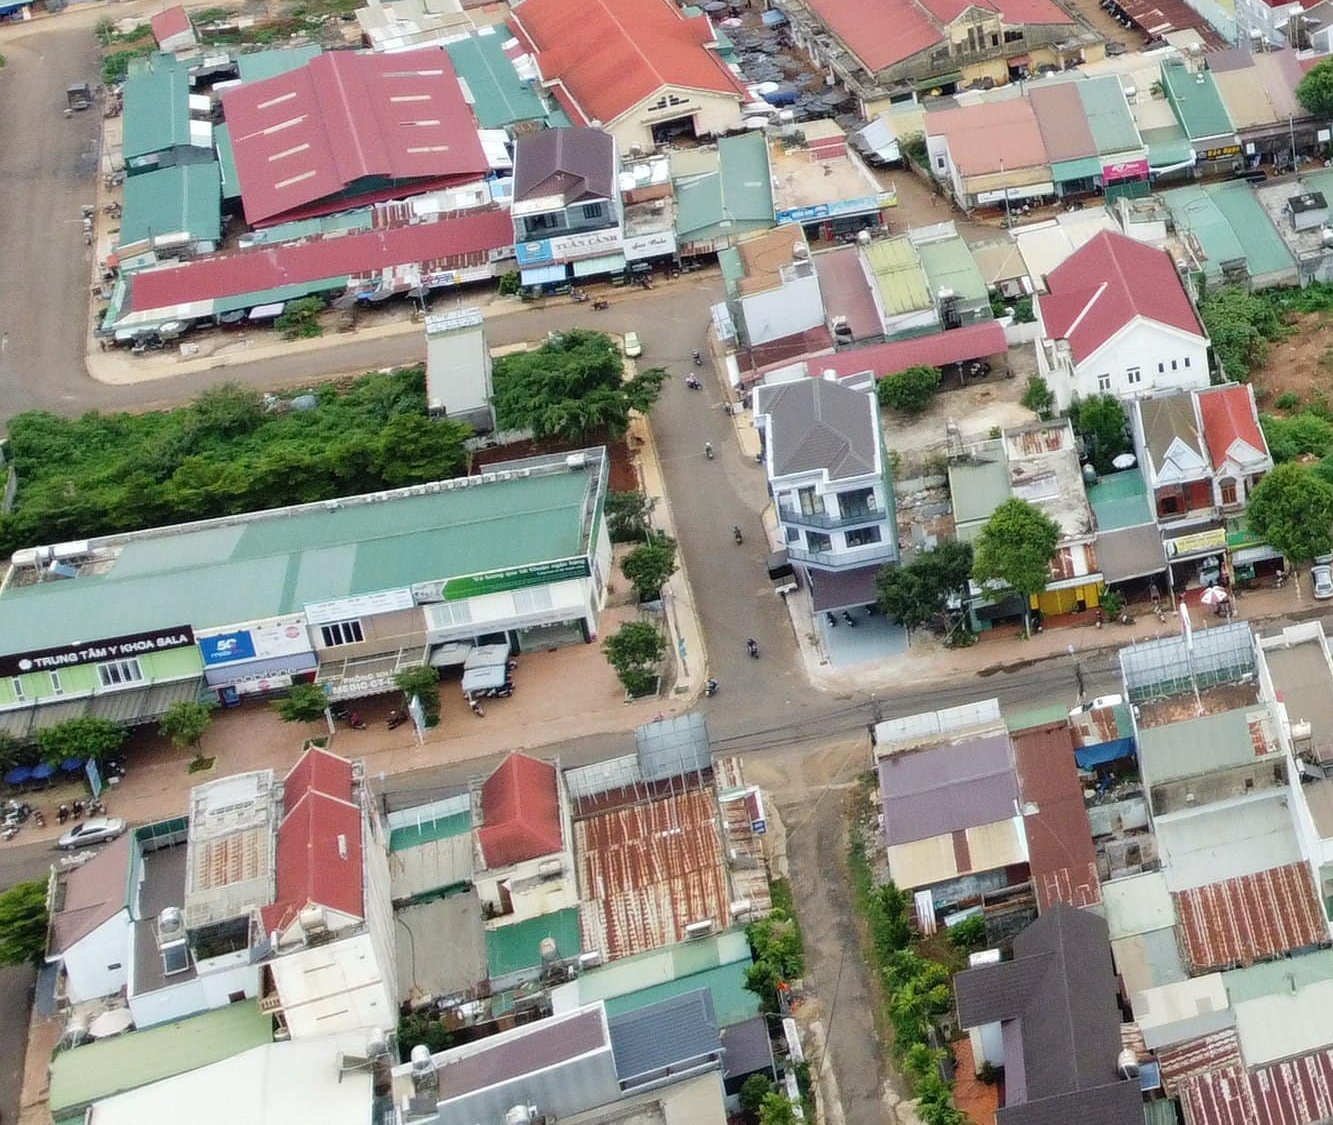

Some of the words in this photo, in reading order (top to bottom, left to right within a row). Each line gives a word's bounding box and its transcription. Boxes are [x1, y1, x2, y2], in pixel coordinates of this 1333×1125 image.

[34, 652, 78, 668] TRUNG
[80, 643, 108, 660] TÂM
[108, 646, 119, 656] Y
[120, 640, 156, 655] KHOA
[156, 633, 188, 648] SALA
